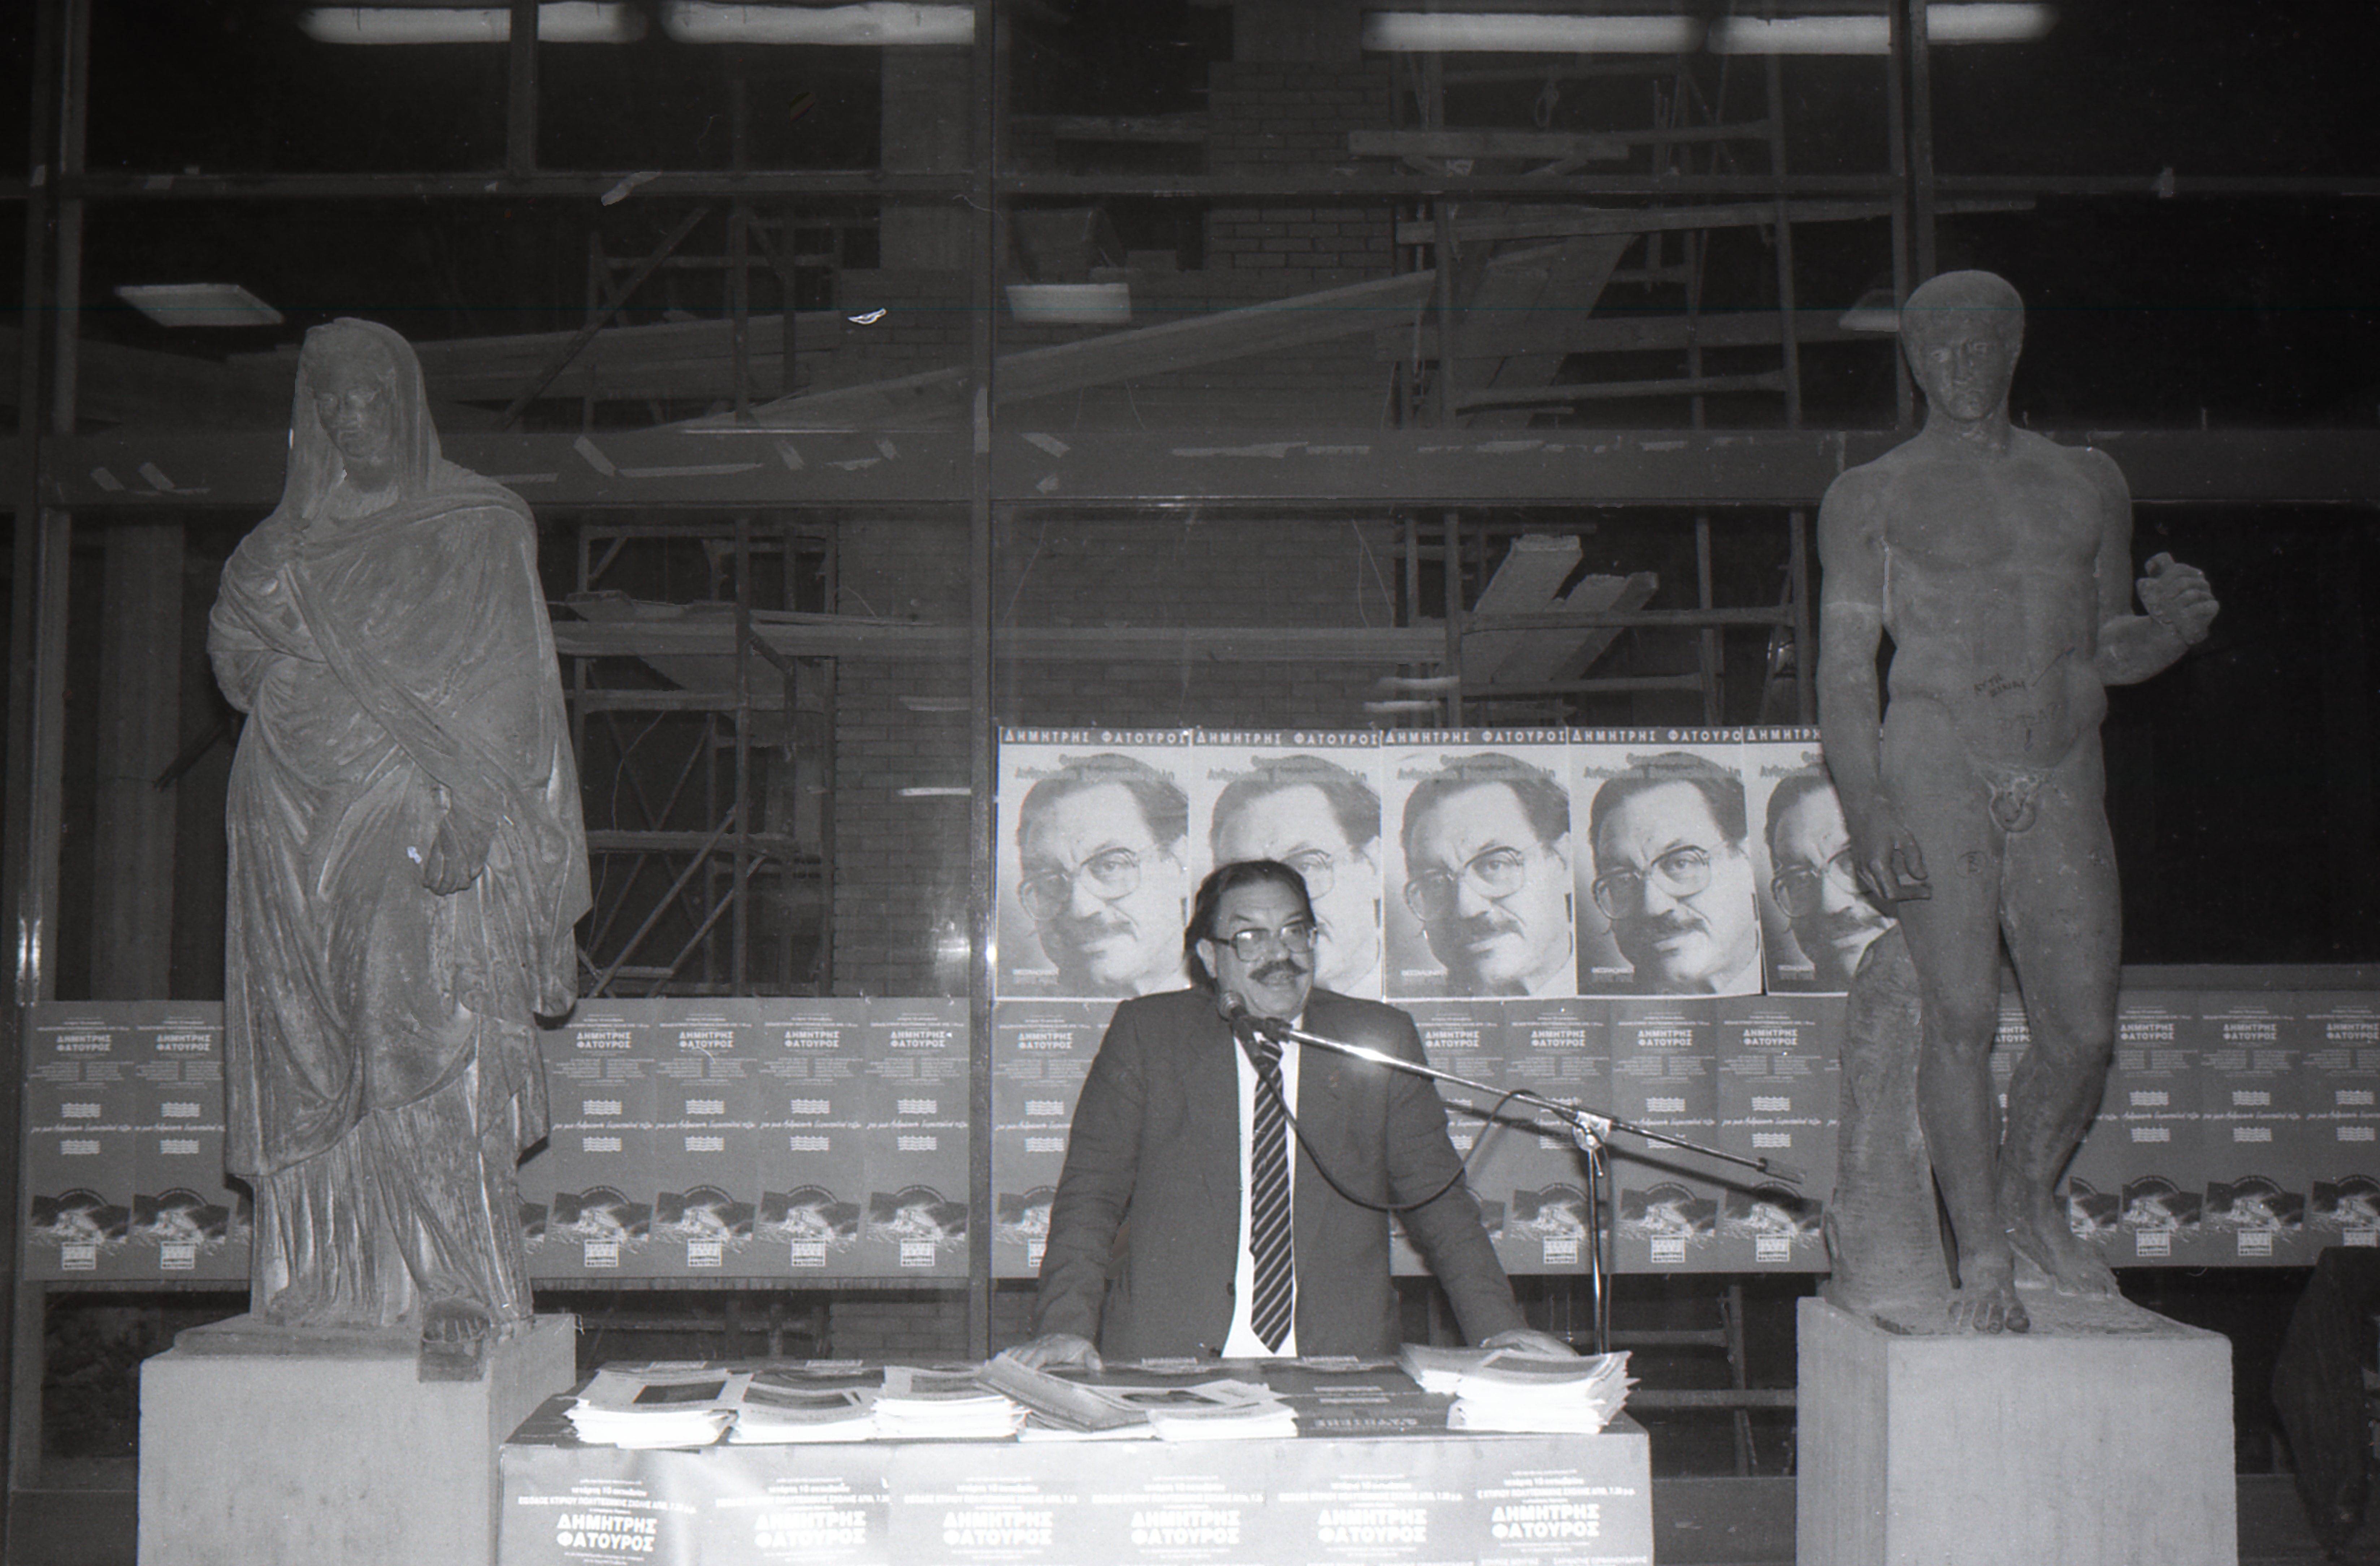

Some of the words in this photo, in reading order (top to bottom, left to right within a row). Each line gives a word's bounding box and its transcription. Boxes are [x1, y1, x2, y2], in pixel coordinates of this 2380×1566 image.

[1004, 730, 1089, 743] ΔΗΜΗΤΡΗΣ
[1101, 731, 1186, 744] ΦΑΤΟΥΡΟΣ
[1196, 731, 1282, 744] ΔΗΜΗΤΡΗΣ
[1293, 732, 1377, 745] ΦΑΤΟΥΡΟΣ
[1385, 731, 1469, 743] ΔΗΜΗΤΡΗΣ
[1482, 730, 1564, 742] ΦΑΤΟΥΡΟΣ
[1572, 730, 1656, 742] ΔΗΜΗΤΡΗΣ
[157, 1034, 211, 1042] ΔΗΜΗΤΡΗΣ
[577, 1031, 631, 1040] ΔΗΜΗΤΡΗΣ
[1018, 1032, 1072, 1041] ΔΗΜΗΤΡΗΣ
[1425, 1031, 1479, 1039] ΔΗΜΗΤΡΗΣ
[57, 1043, 110, 1051] ΦΑΤΟΥΡΟΣ
[157, 1043, 210, 1051] ΦΑΤΟΥΡΟΣ
[679, 1040, 733, 1048] ΦΑΤΟΥΡΟΣ
[755, 1511, 866, 1530] ΔΗΜΗΤΡΗΣ
[942, 1511, 1053, 1528] ΔΗΜΗΤΡΗΣ
[1131, 1510, 1240, 1527] ΔΗΜΗΤΡΗΣ
[1318, 1509, 1427, 1525] ΔΗΜΗΤΡΗΣ
[1492, 1504, 1600, 1522] ΔΗΜΗΤΡΗΣ
[557, 1513, 658, 1534] ΔΗΜΗΤΡΗΣ
[1492, 1521, 1600, 1539] ΦΑΤΟΥΡΟΣ
[556, 1531, 655, 1552] ΦΑΤΟΥΡΟΣ
[754, 1528, 866, 1547] ΦΑΤΟΥΡΟΣ
[943, 1528, 1052, 1545] ΦΑΤΟΥΡΟΣ
[1131, 1528, 1240, 1545] ΦΑΤΟΥΡΟΣ
[1318, 1526, 1426, 1543] ΦΑΤΟΥΡΟΣ
